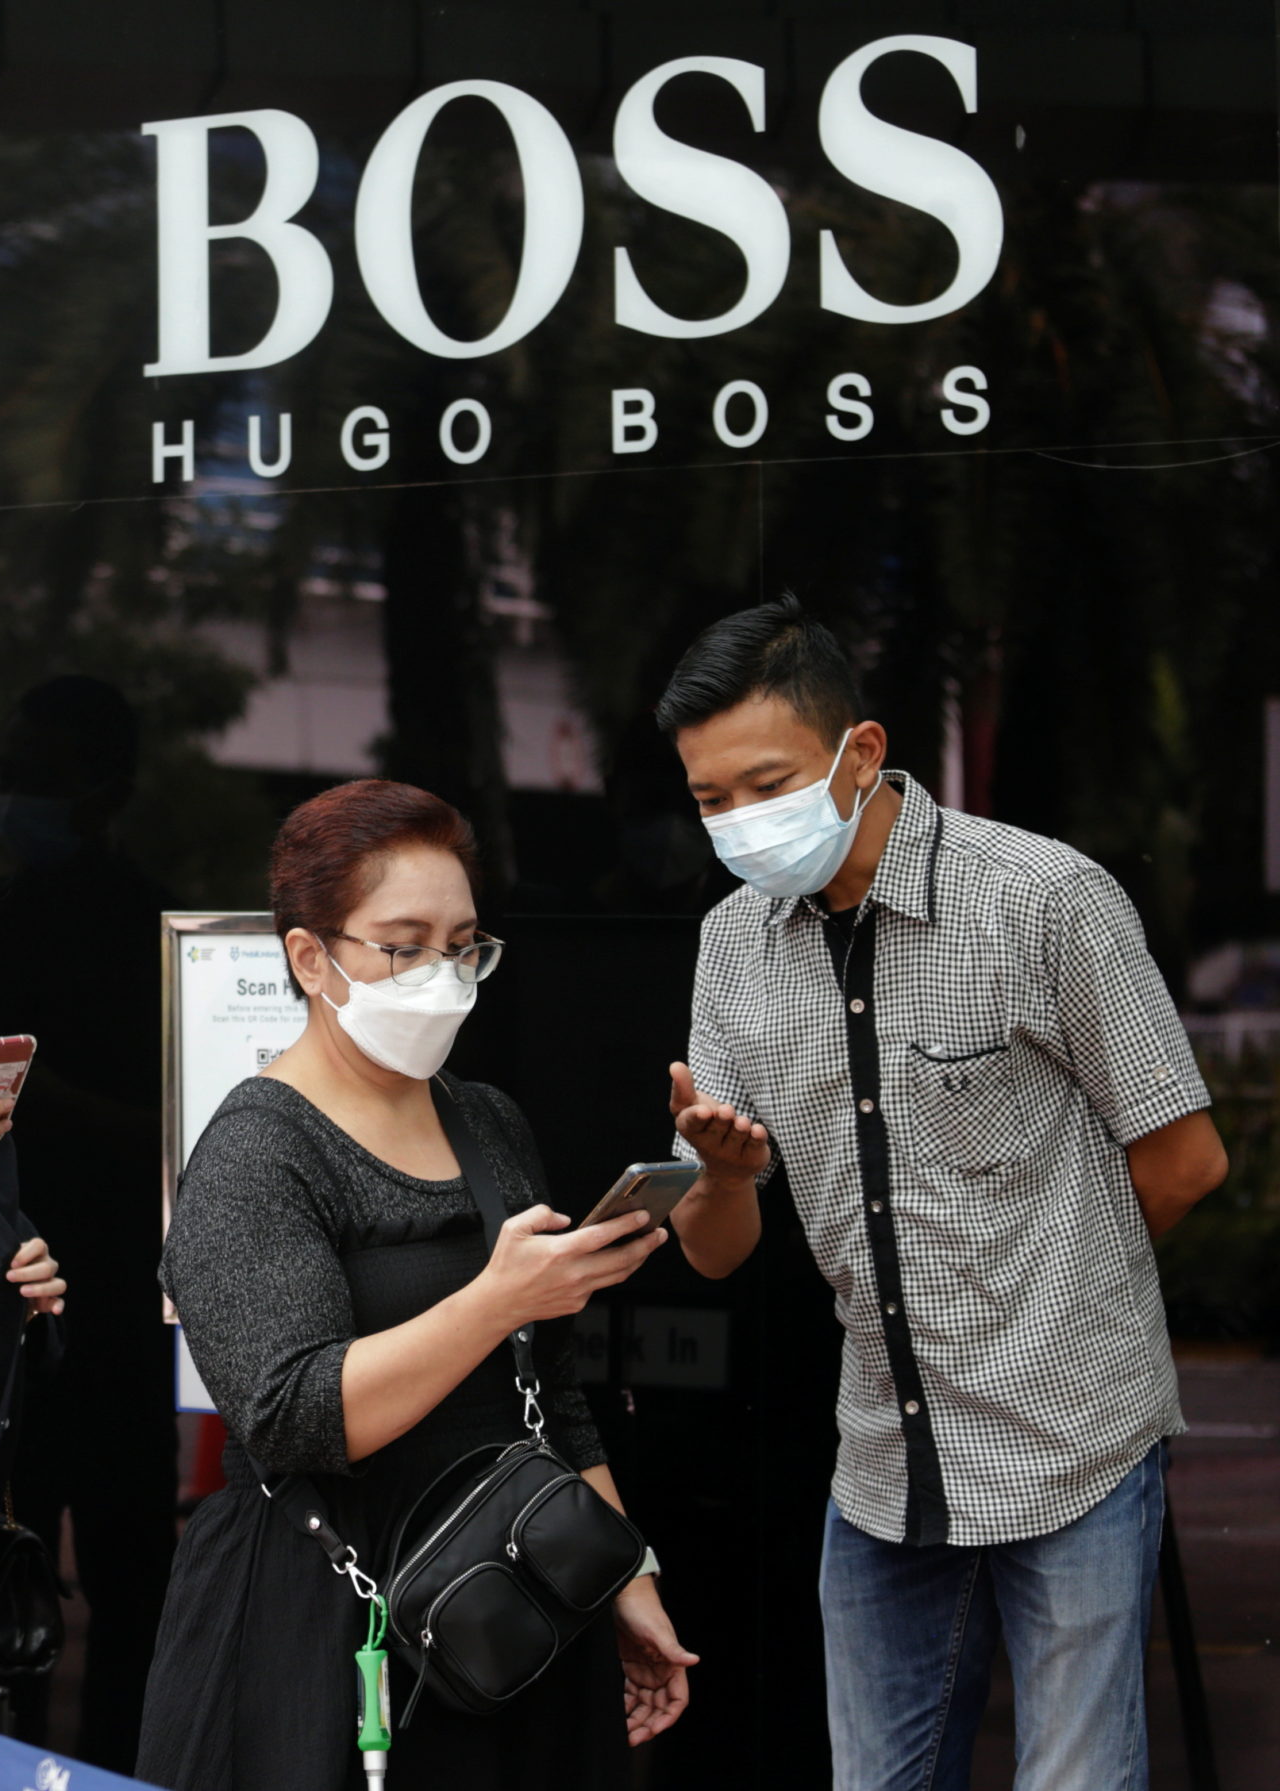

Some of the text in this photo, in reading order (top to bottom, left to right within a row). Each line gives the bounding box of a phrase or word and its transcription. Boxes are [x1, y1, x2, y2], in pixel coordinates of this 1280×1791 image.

[142, 34, 1004, 377] BOSS
[153, 366, 991, 483] HUGO BOSS
[236, 978, 277, 996] Scan
